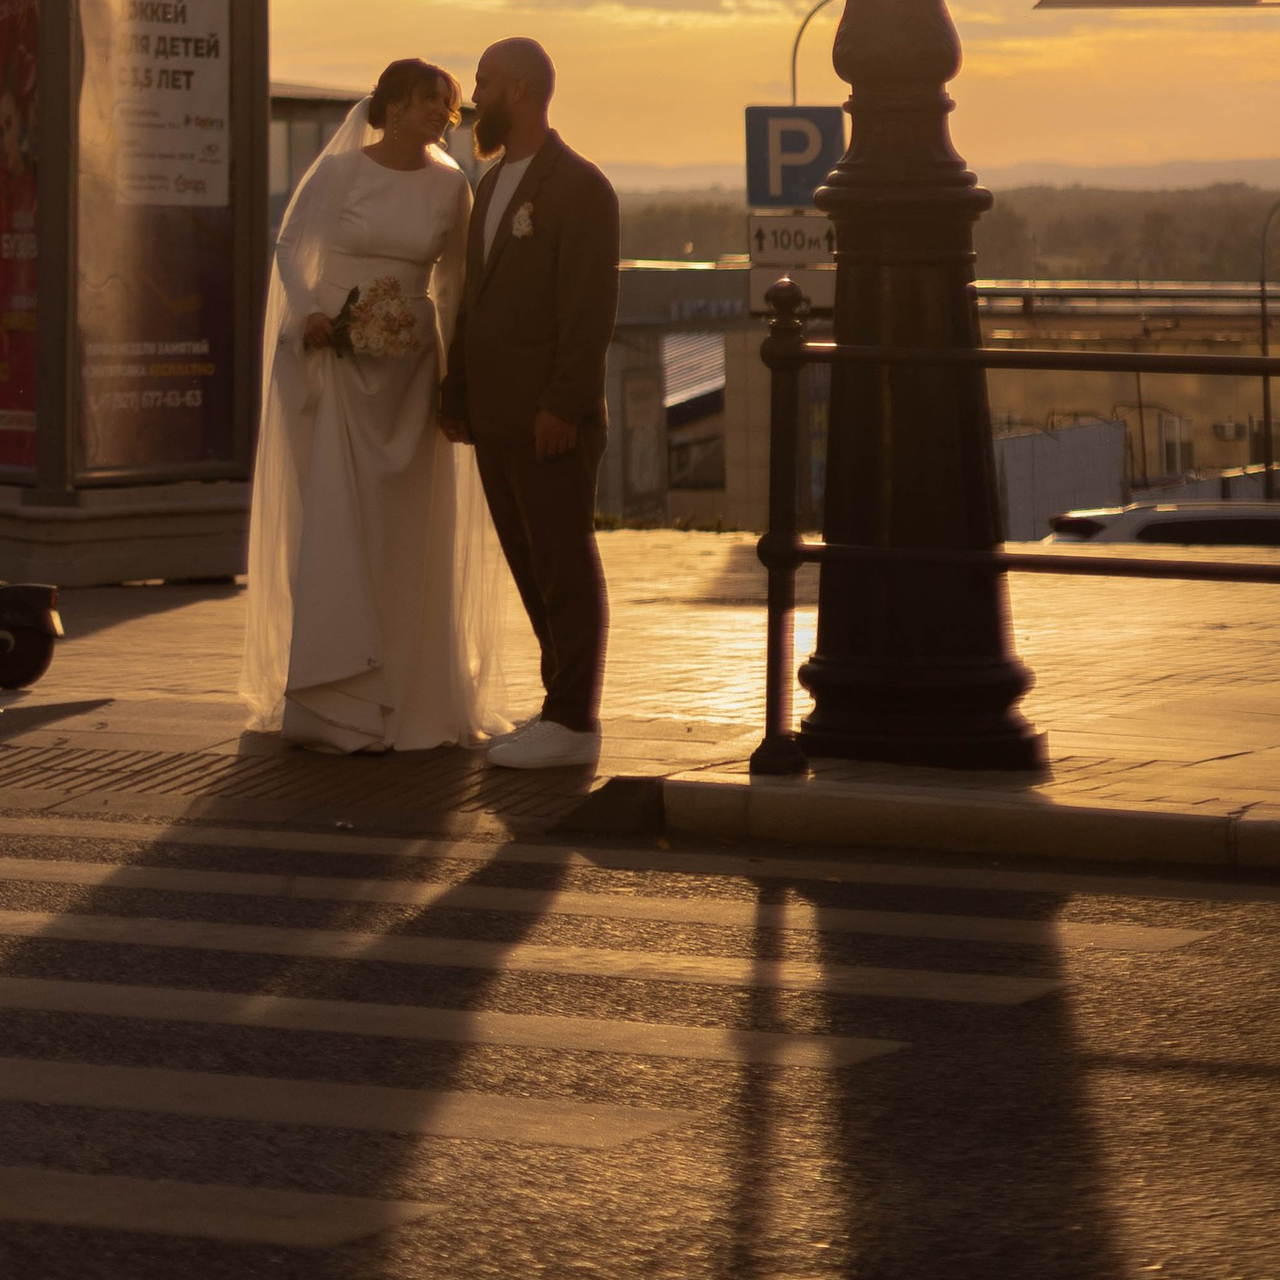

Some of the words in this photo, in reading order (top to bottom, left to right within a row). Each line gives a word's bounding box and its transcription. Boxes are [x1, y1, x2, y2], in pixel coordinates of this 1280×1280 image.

[154, 31, 221, 60] ДЕТЕЙ
[156, 68, 195, 91] ЛЕТ
[767, 117, 823, 197] P
